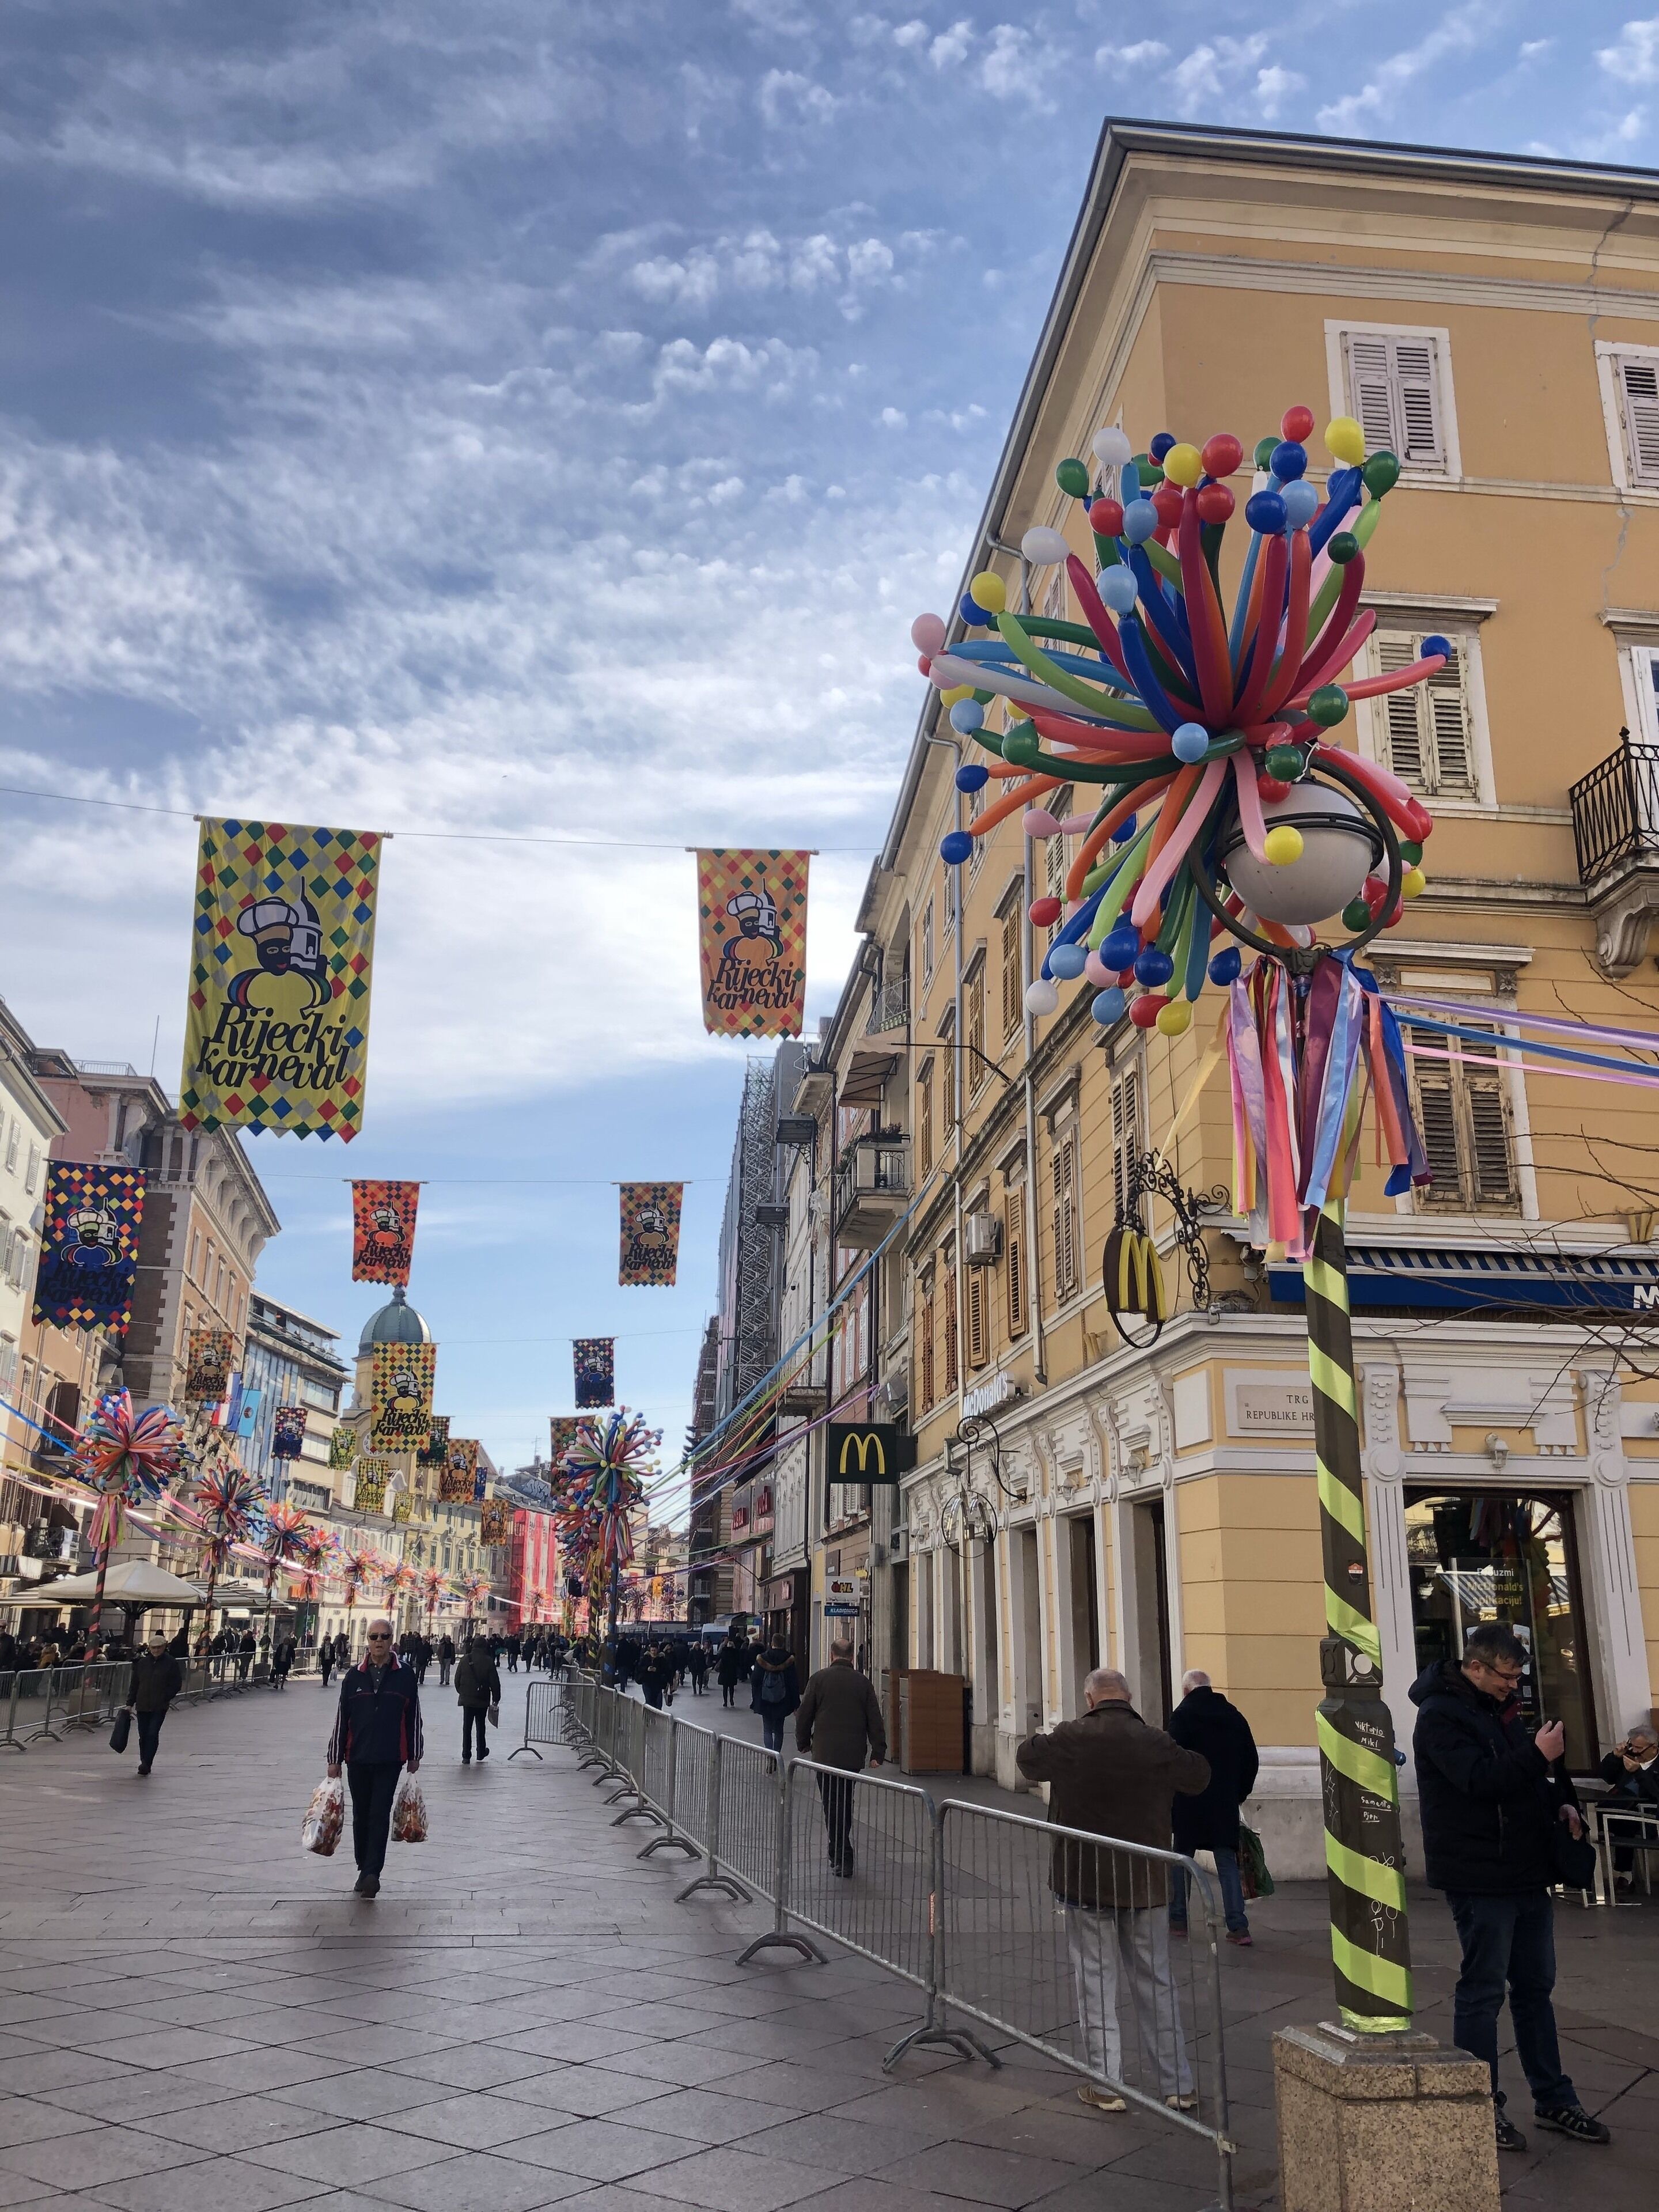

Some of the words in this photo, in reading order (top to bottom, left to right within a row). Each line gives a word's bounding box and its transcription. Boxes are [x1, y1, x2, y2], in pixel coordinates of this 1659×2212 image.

[714, 957, 793, 993] Riječki
[707, 979, 797, 1010] karneval
[213, 1002, 347, 1063] Riječki
[196, 1036, 350, 1090] karneval
[963, 1370, 1007, 1425] McDonald's
[1286, 1395, 1309, 1404] TRG
[1246, 1410, 1297, 1421] REPUBLIKE
[1354, 1721, 1384, 1735] Viktorio
